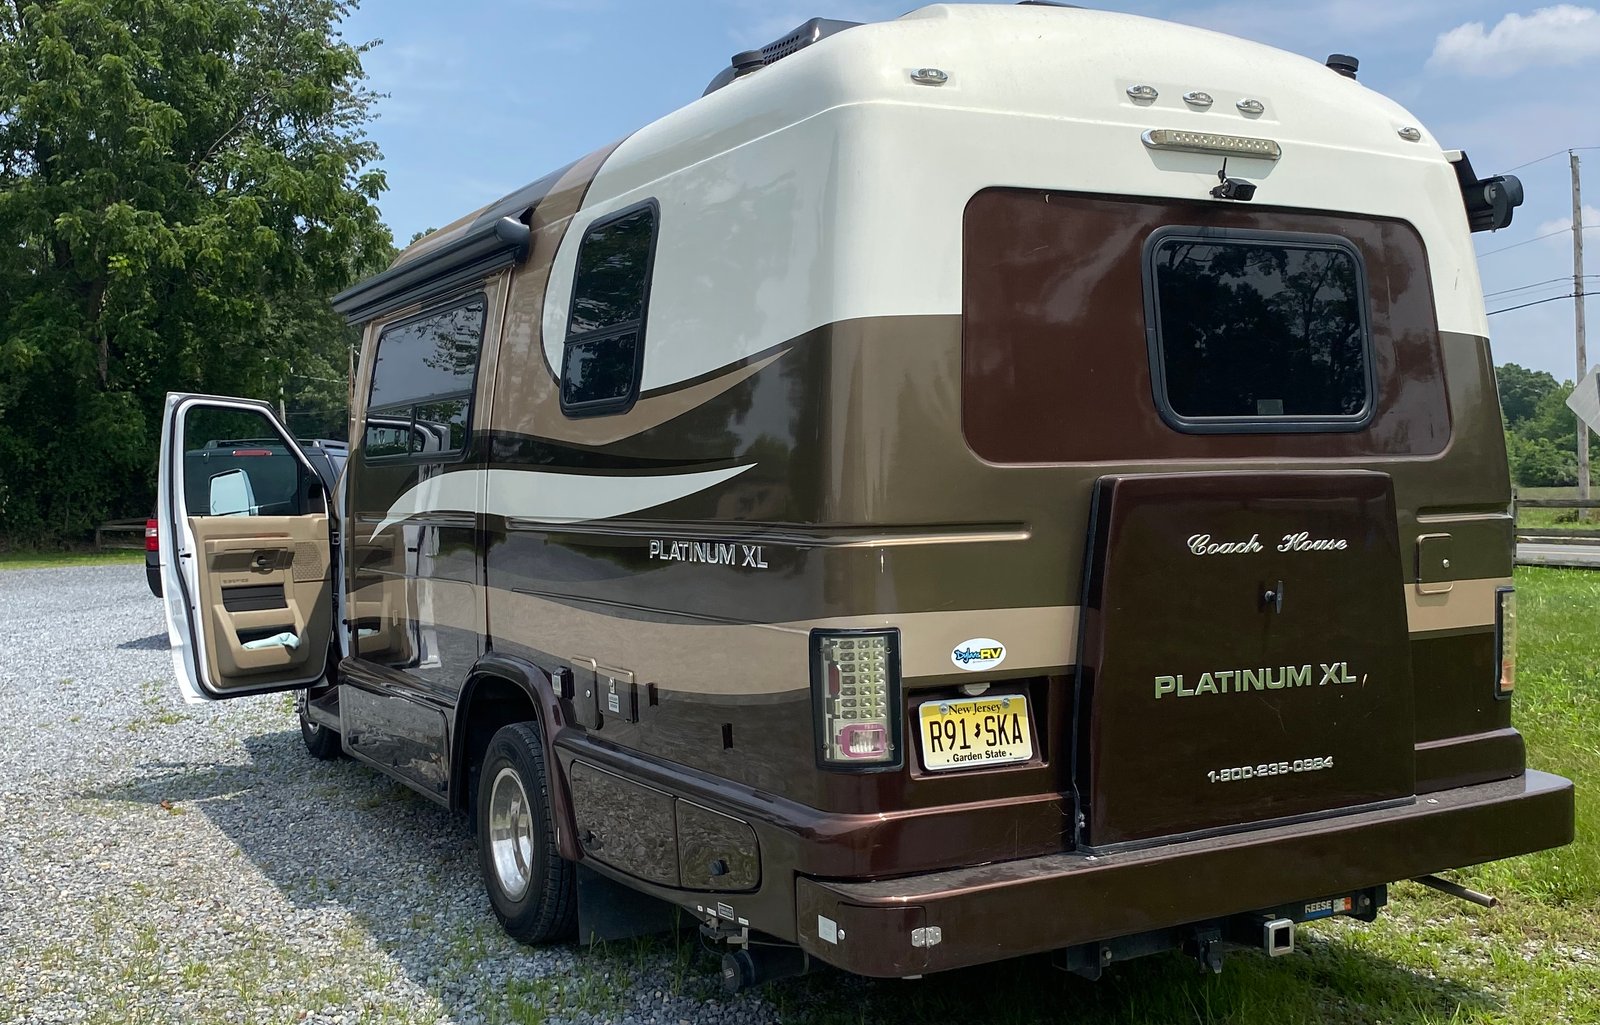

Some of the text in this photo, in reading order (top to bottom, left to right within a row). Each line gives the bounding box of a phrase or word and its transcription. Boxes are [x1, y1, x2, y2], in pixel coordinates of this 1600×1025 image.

[1187, 531, 1348, 556] Coach House
[649, 539, 769, 569] PLATINUM XL
[980, 647, 1003, 660] RV
[1154, 661, 1357, 699] PLATINUM XL
[948, 703, 1001, 715] New Jersey
[952, 749, 1007, 762] Garden State
[1207, 756, 1334, 783] 1-800-235-0984
[1304, 900, 1332, 914] REESE
